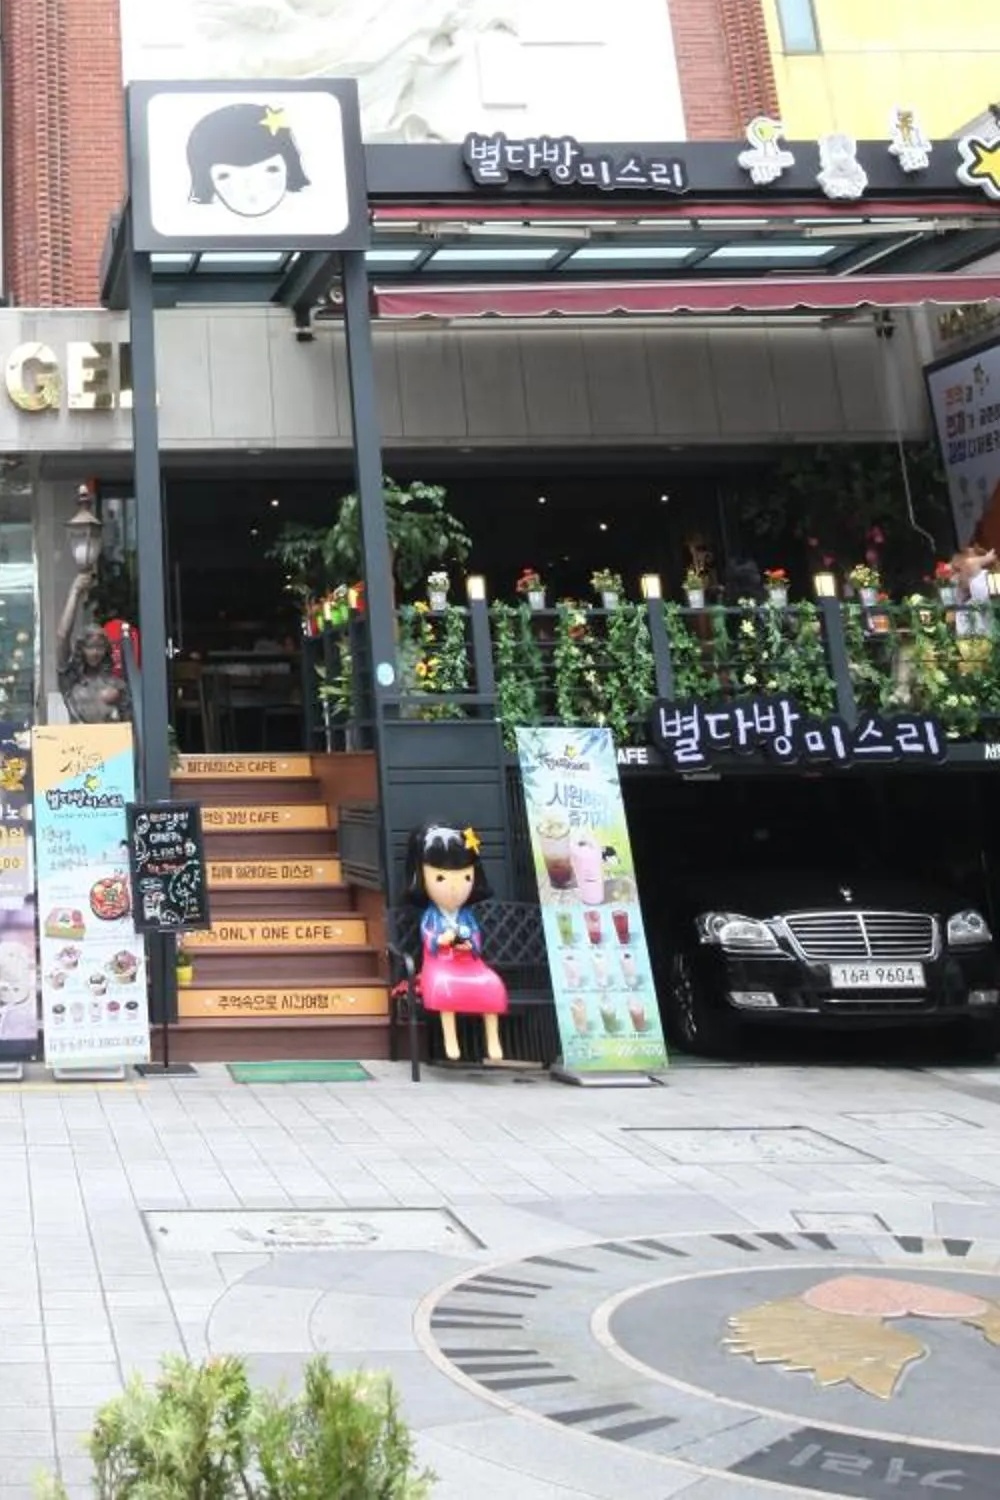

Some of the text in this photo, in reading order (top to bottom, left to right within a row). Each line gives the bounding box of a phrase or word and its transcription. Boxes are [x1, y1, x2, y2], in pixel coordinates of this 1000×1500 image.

[617, 747, 648, 765] AFE
[220, 927, 256, 941] ONLY
[261, 926, 289, 940] ONE
[295, 926, 332, 939] CAFE
[875, 966, 915, 984] 9604
